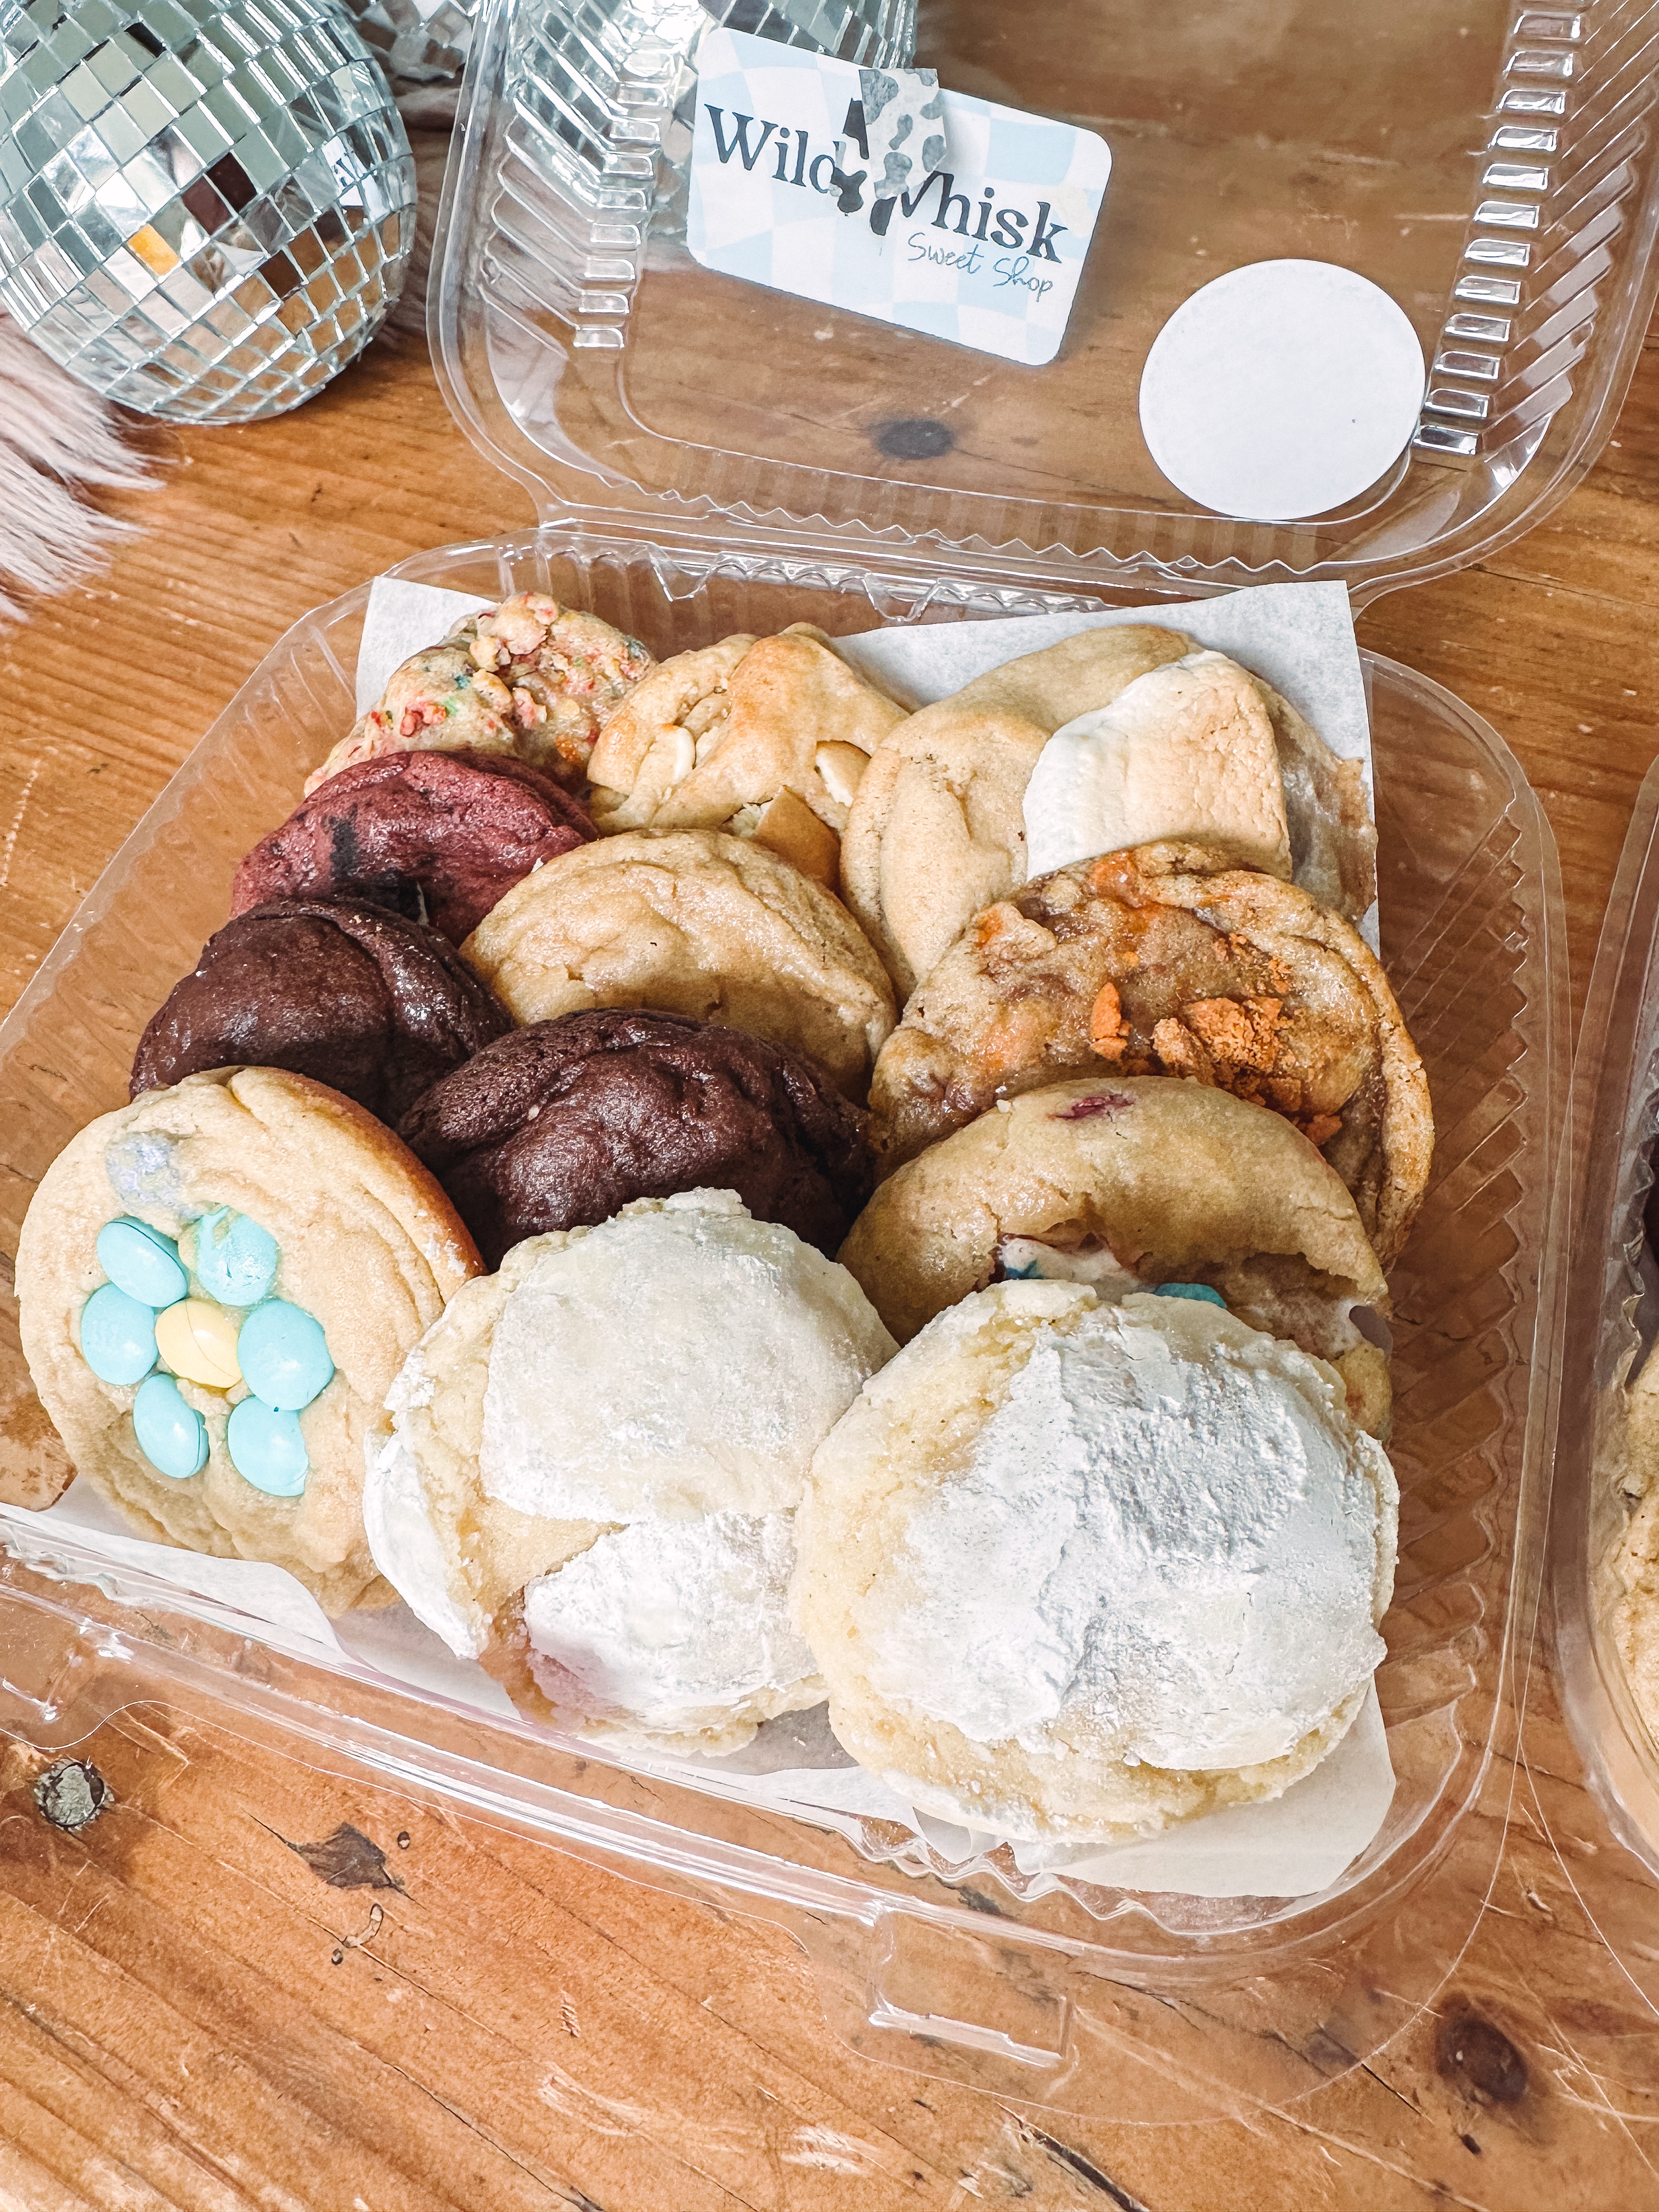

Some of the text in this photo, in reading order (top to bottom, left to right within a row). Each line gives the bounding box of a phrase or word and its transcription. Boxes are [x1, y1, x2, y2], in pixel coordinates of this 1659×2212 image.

[703, 103, 846, 195] Wild
[907, 232, 1053, 303] Sweet Shop
